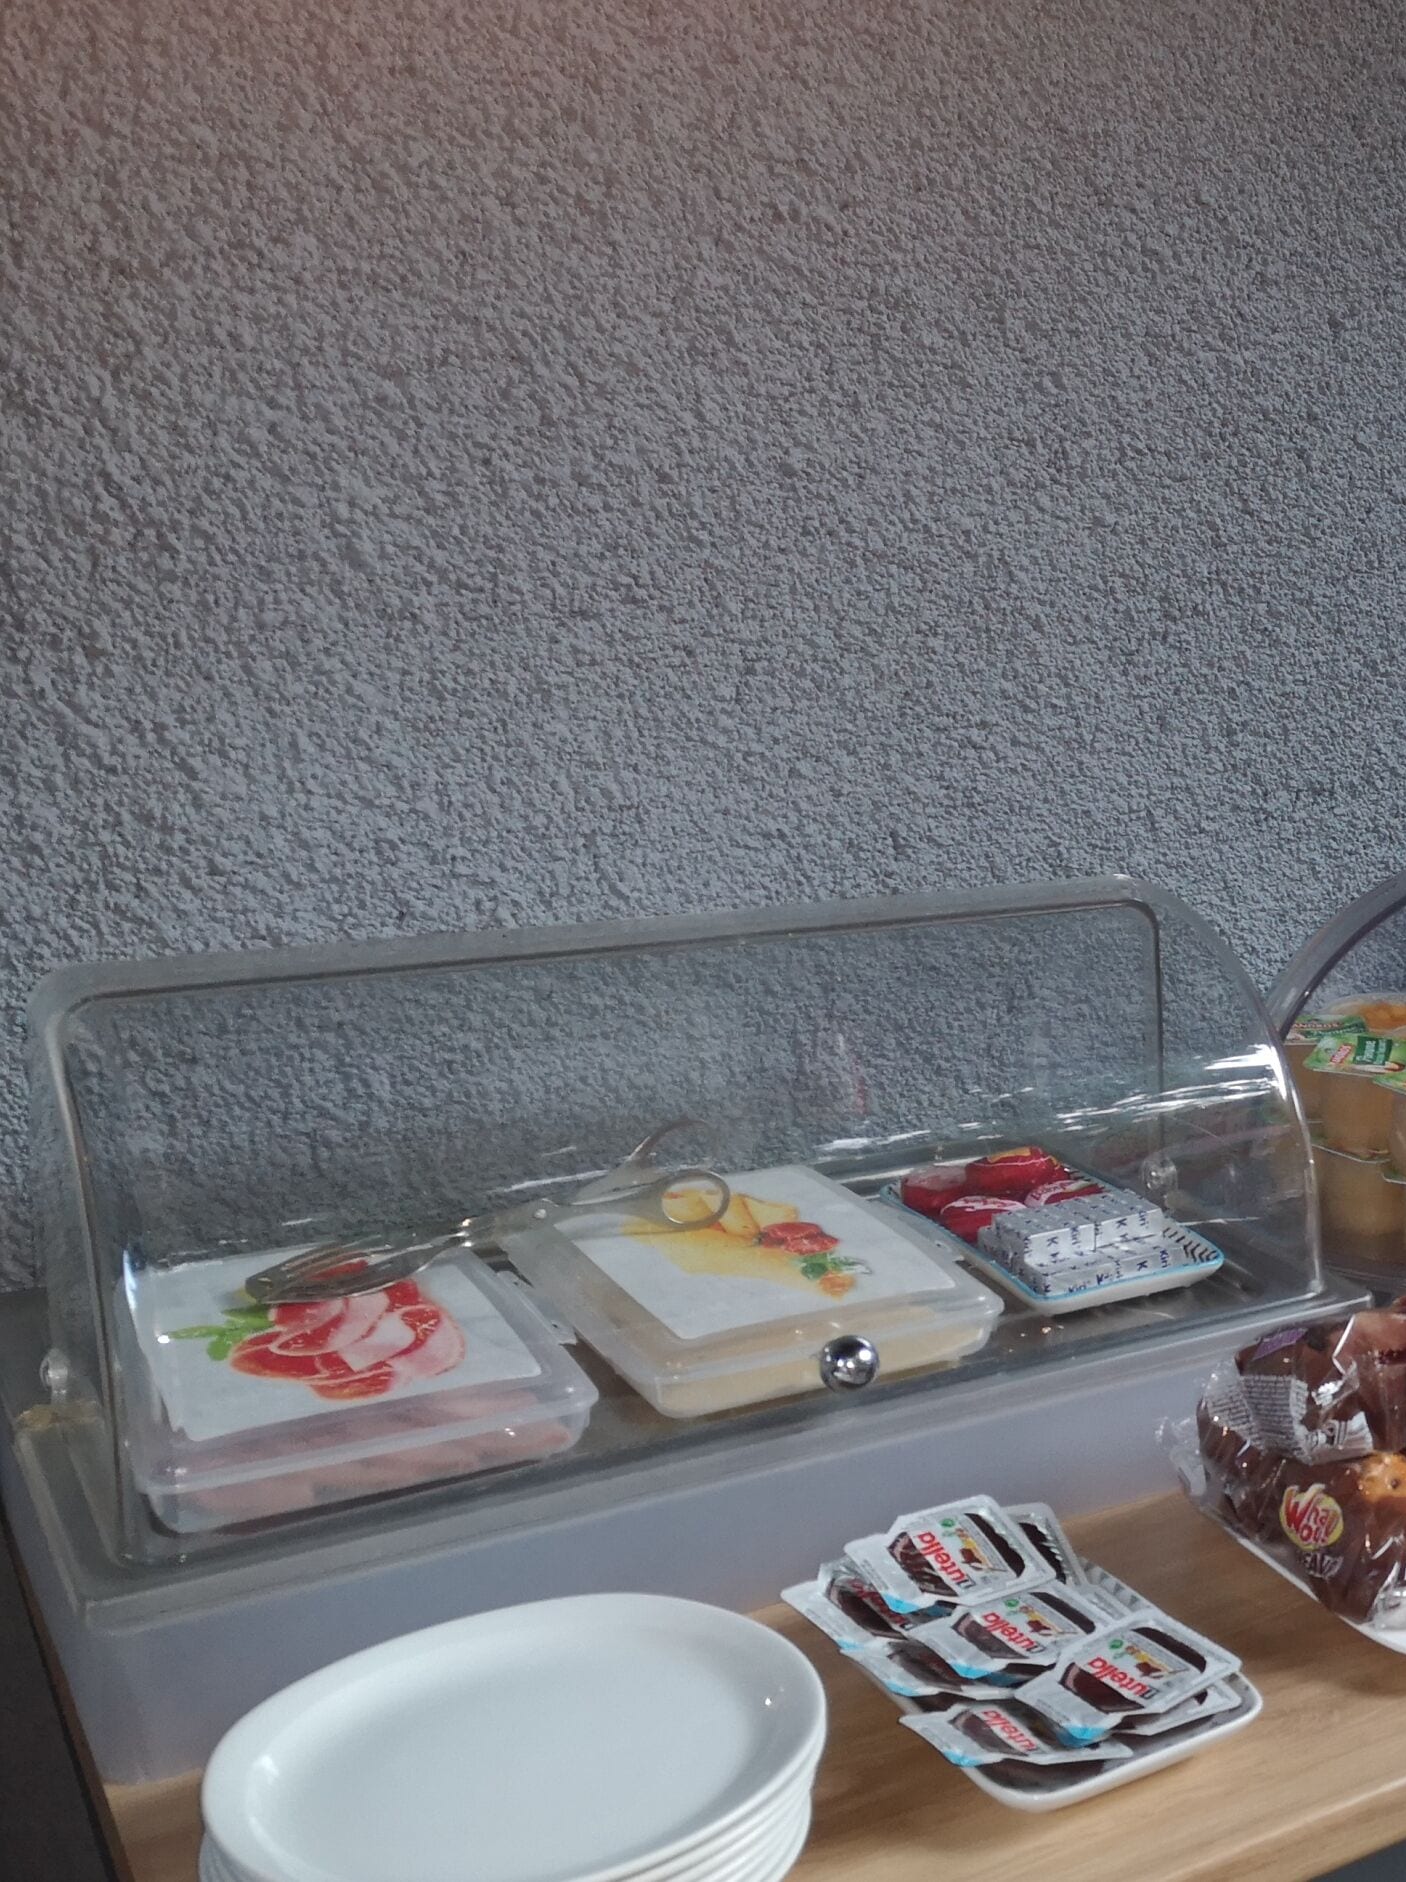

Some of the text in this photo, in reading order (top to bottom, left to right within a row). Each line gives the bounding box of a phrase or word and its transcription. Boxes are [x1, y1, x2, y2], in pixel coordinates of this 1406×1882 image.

[917, 1531, 977, 1592] nutella
[982, 1611, 1047, 1654] nutella
[1087, 1656, 1161, 1700] nutella
